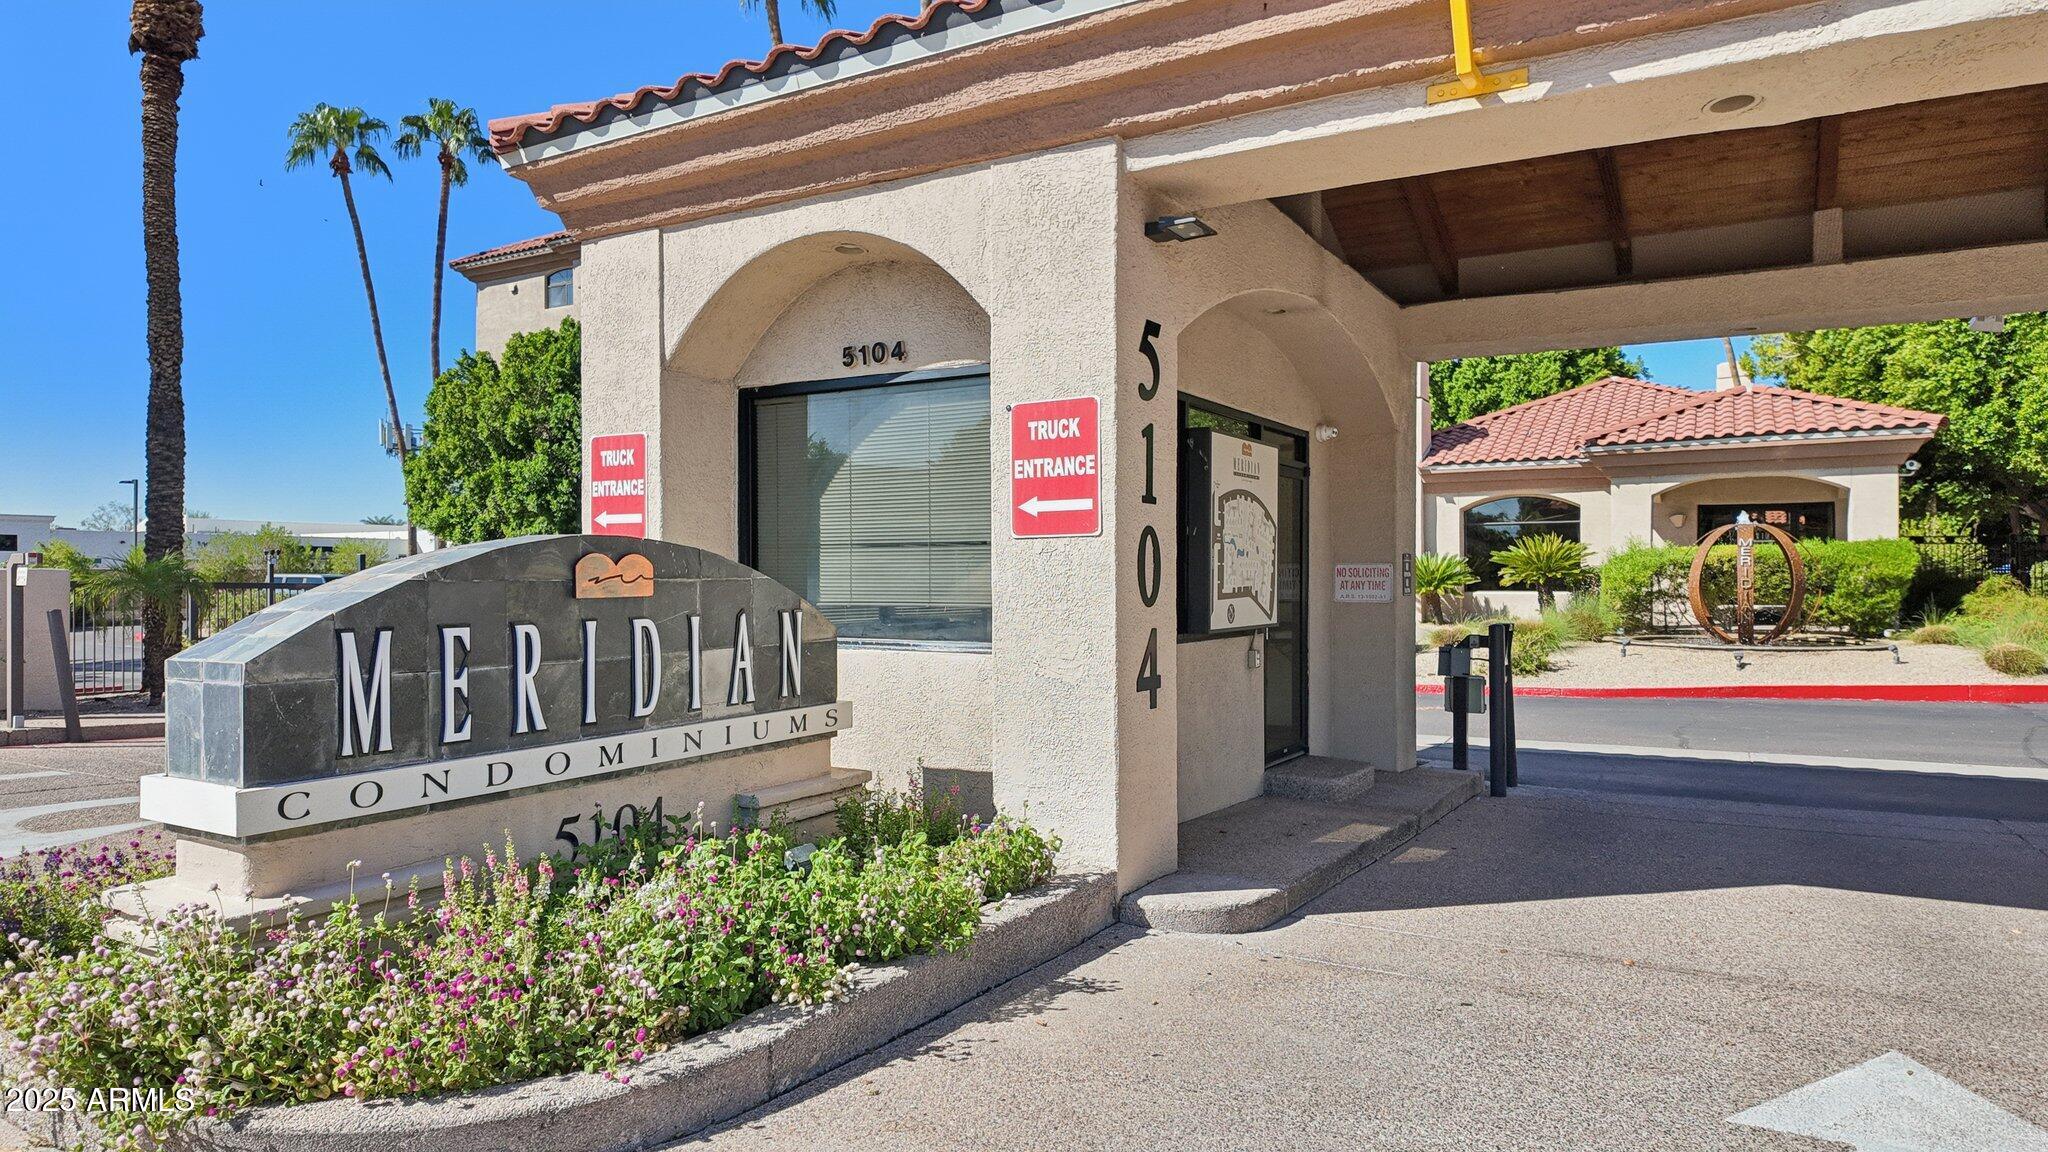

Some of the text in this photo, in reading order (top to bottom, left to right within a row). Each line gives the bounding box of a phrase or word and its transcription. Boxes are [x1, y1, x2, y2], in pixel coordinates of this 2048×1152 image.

[841, 340, 908, 368] 5104
[1027, 417, 1081, 441] TRUCK
[600, 448, 635, 468] TRUCK
[1014, 454, 1096, 480] ENTRANCE
[592, 478, 645, 498] ENTRANCE
[1136, 319, 1162, 709] 5104
[1336, 567, 1390, 578] NO SOLICITING
[1339, 580, 1387, 591] AT ANY TIME
[337, 608, 804, 760] MERIDIAN
[276, 707, 840, 821] CONDOMINIUMS
